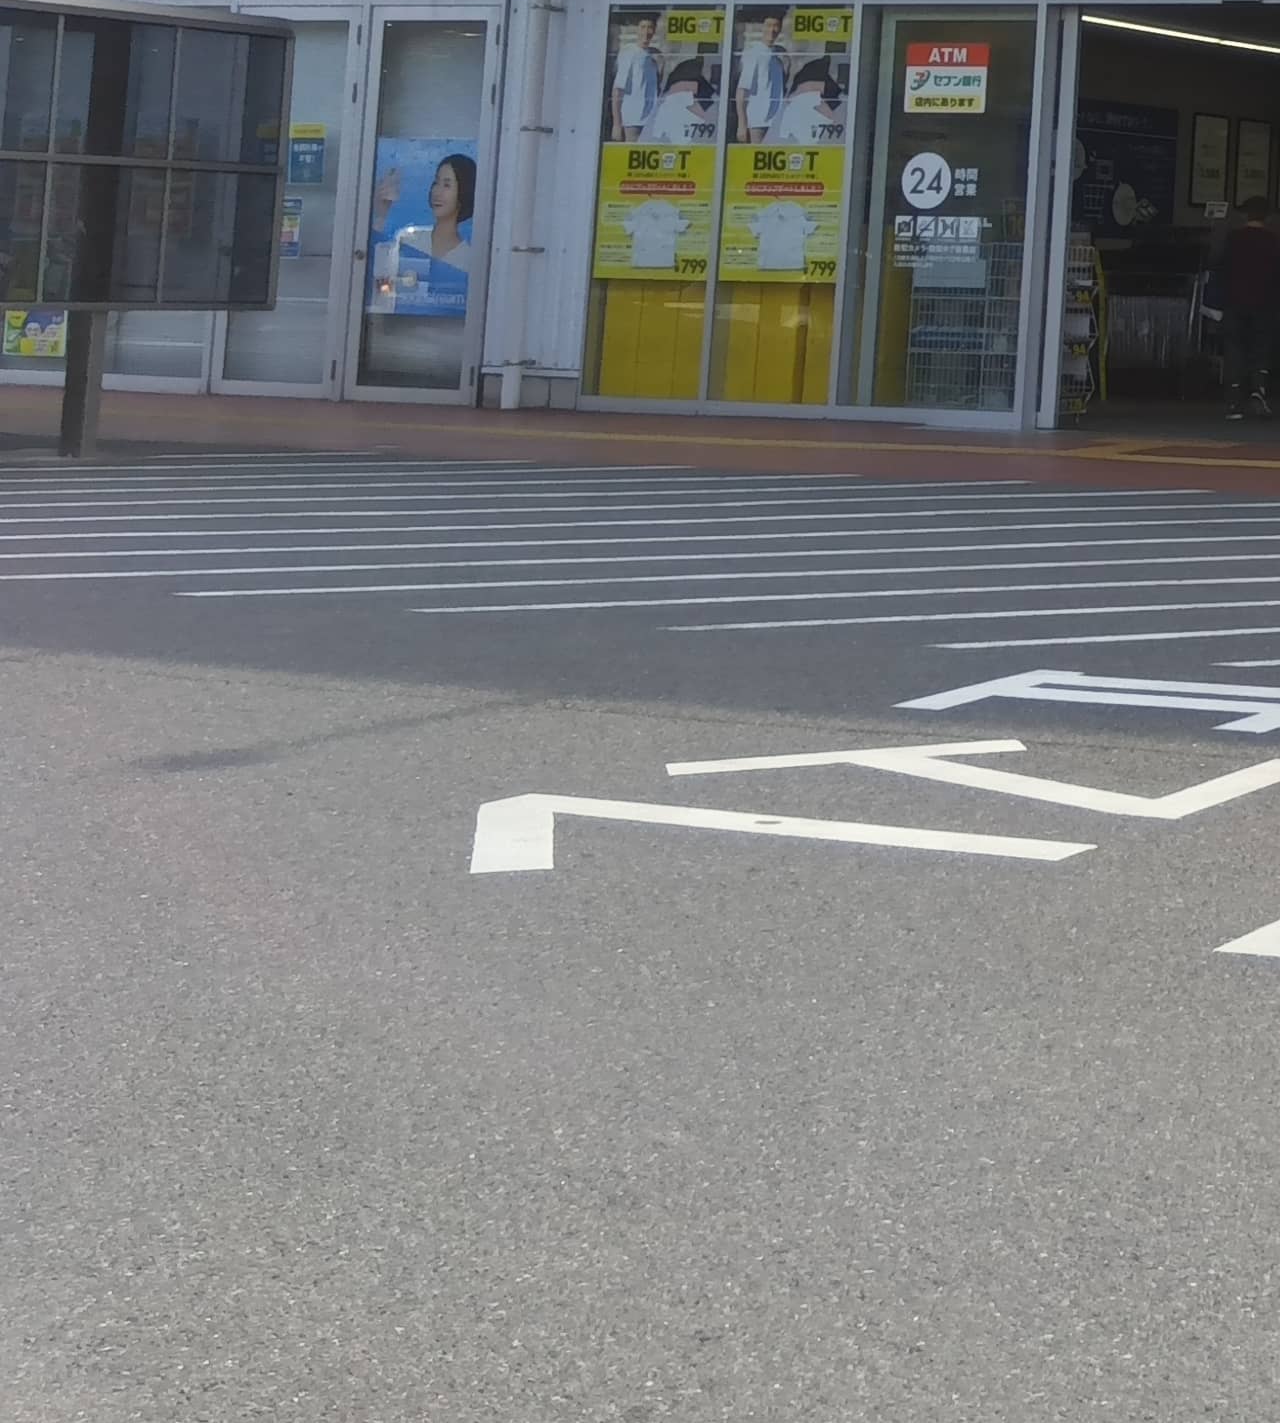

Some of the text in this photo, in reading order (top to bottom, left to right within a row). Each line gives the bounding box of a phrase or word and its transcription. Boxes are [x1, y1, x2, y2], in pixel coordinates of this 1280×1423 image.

[668, 15, 725, 34] BIG T
[794, 15, 852, 33] BIG T
[928, 47, 968, 63] ATM
[933, 74, 982, 88] セブン銀行
[914, 96, 975, 108] 店内にあります
[690, 123, 716, 139] 799
[818, 124, 844, 139] 799
[628, 150, 691, 170] BIG T
[753, 150, 819, 171] BIG T
[909, 167, 943, 194] 24
[954, 167, 979, 182] 時間
[954, 183, 978, 197] 営業
[681, 258, 707, 274] 799
[810, 260, 837, 276] 799
